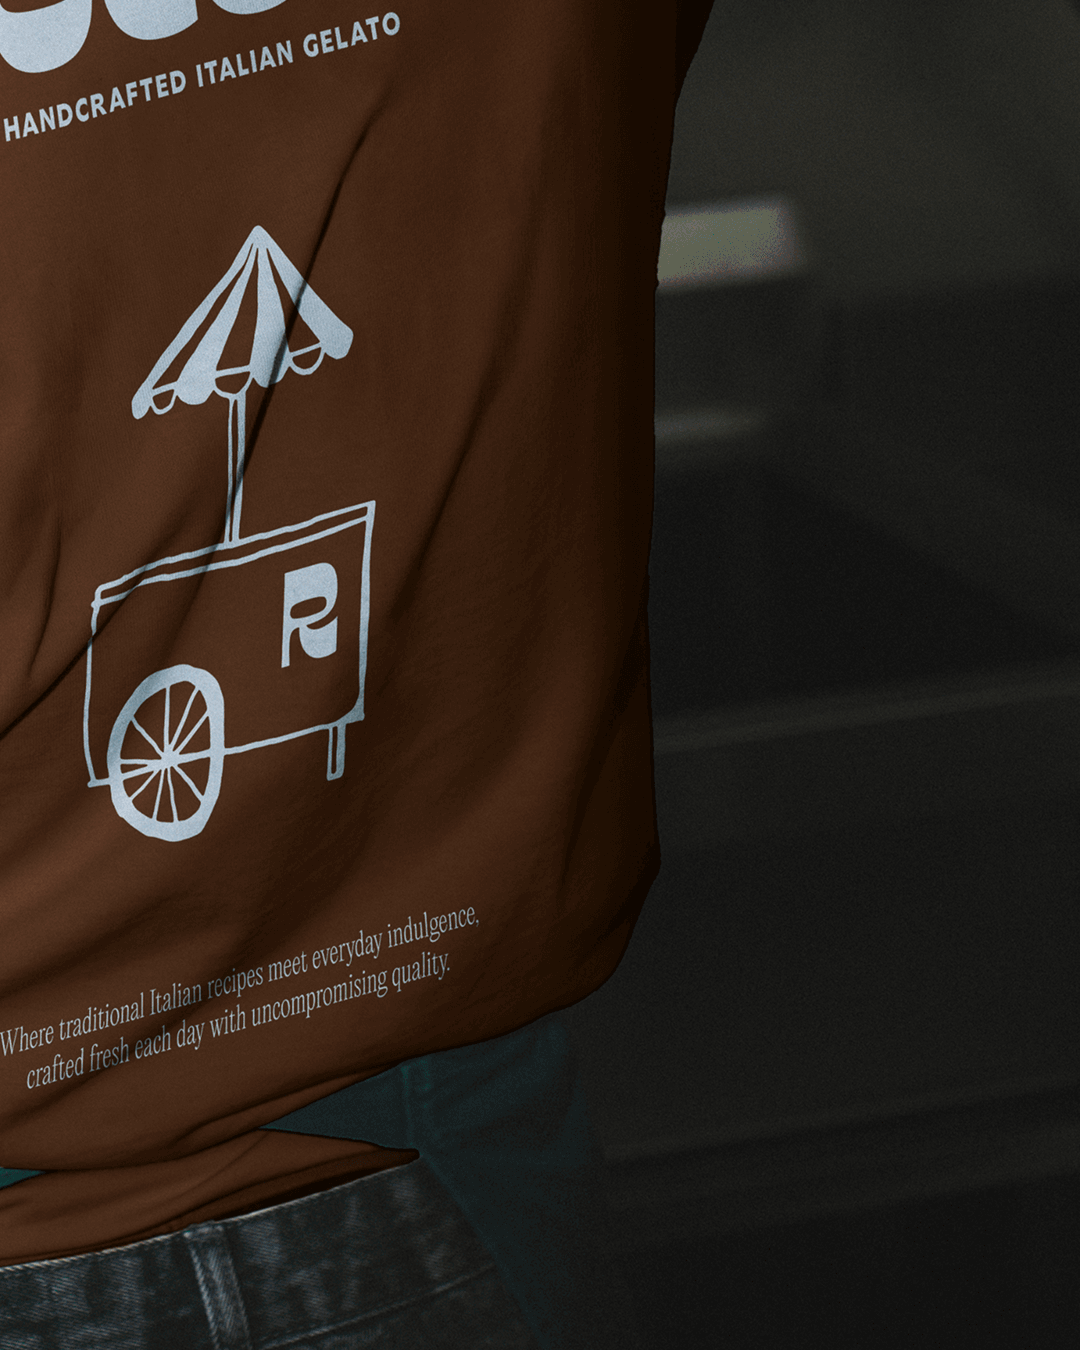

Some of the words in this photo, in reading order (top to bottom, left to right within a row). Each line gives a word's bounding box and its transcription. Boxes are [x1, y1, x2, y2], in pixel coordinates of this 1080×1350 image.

[3, 69, 187, 142] HANDCRAFTED
[195, 39, 294, 88] ITALIAN
[303, 11, 401, 58] GELATO
[281, 562, 338, 669] R
[0, 1024, 54, 1057] Where
[59, 991, 144, 1041] traditional
[149, 982, 202, 1016] Italian
[207, 965, 264, 1000] recipes
[268, 951, 308, 983] meet
[312, 929, 383, 967] everyday
[26, 1047, 84, 1090] crafted
[88, 1036, 130, 1073] fresh
[134, 1024, 172, 1060] each
[176, 1019, 206, 1051] day
[209, 1003, 247, 1038] with
[251, 970, 388, 1027] uncompromising
[391, 951, 451, 993] quality.
